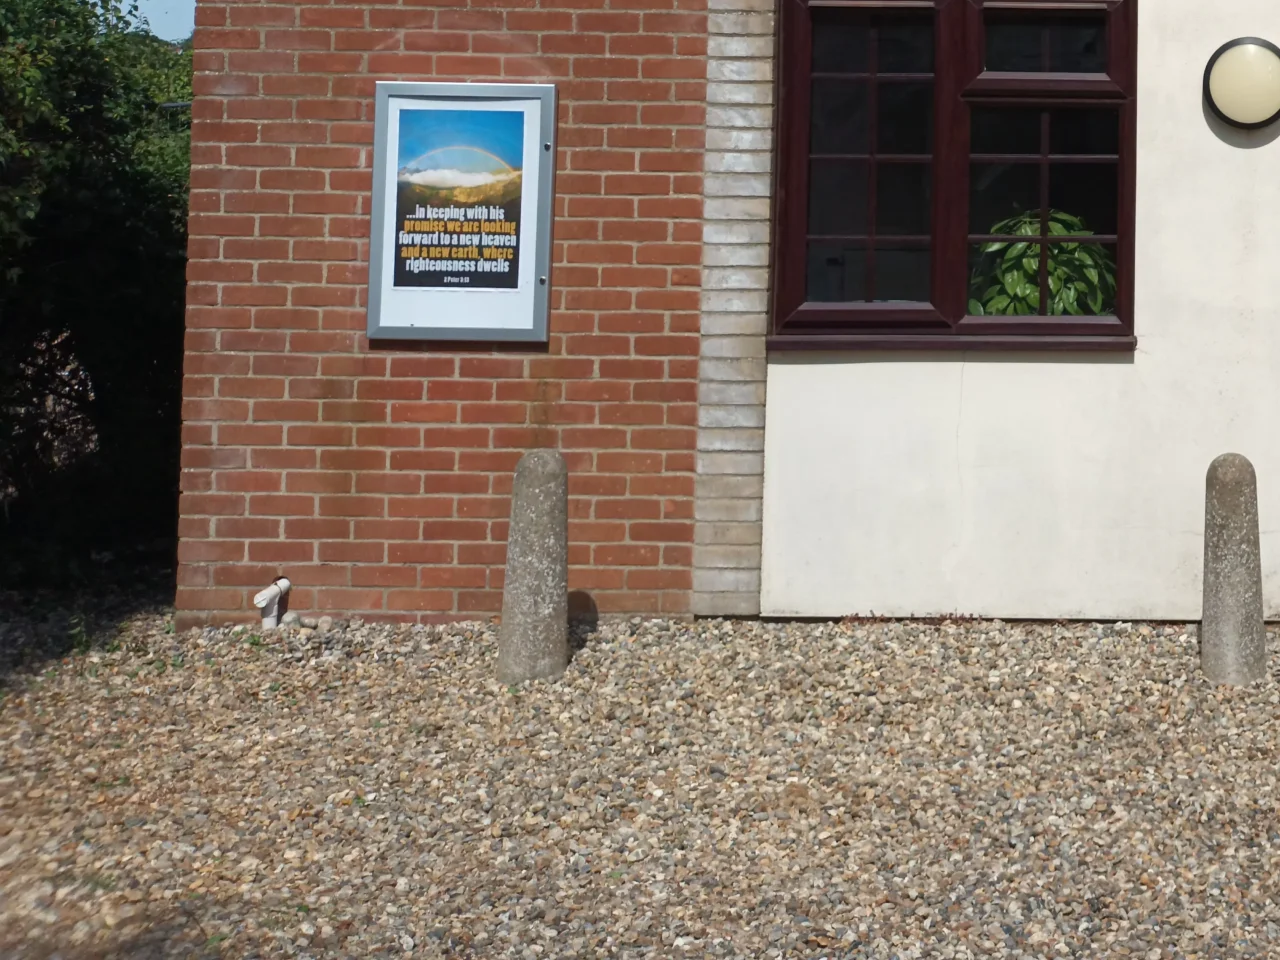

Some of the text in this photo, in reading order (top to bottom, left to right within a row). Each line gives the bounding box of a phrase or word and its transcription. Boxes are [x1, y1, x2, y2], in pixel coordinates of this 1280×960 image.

[426, 204, 465, 221] keeping
[466, 205, 488, 220] with
[490, 206, 504, 220] his
[404, 218, 516, 234] promise we are looking
[398, 230, 516, 246] forward to a new heaven
[401, 244, 514, 260] and a new earth, where
[406, 256, 510, 274] righteousness dwells
